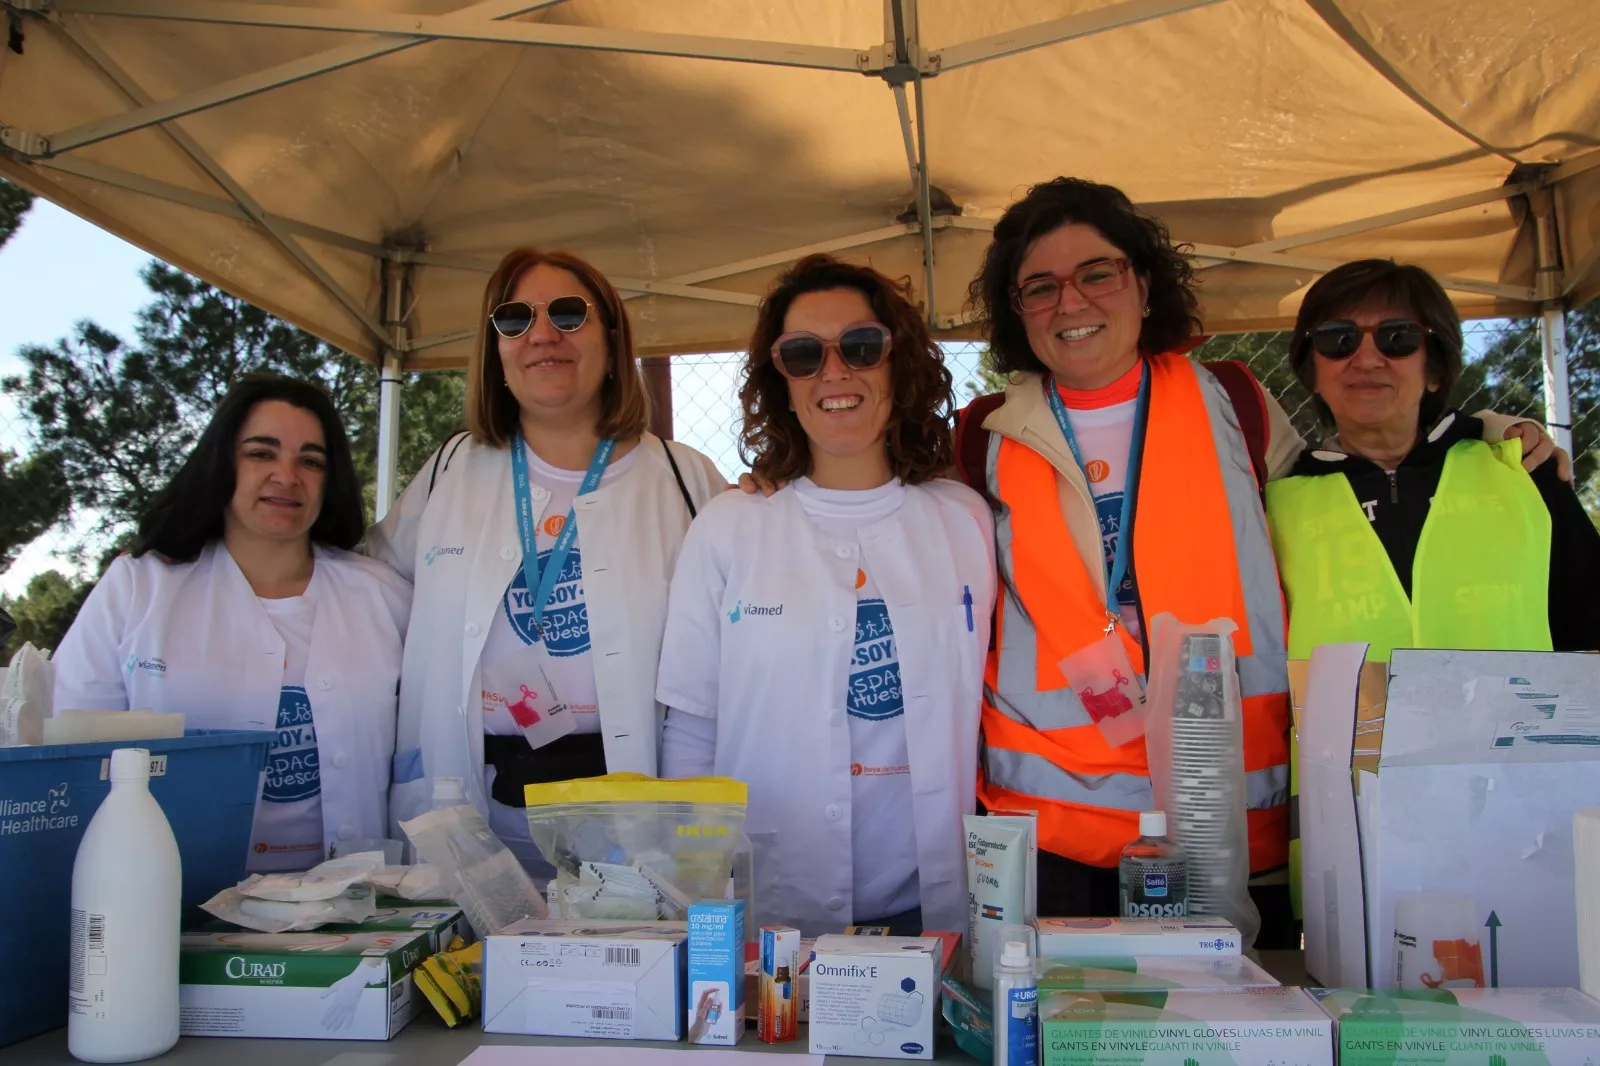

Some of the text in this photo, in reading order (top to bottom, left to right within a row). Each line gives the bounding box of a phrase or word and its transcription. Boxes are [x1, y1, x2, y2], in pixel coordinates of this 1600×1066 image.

[743, 603, 783, 616] viamed
[856, 640, 892, 666] SOY
[1, 814, 78, 835] Healthcare
[816, 963, 878, 978] Omnifix E
[1020, 991, 1038, 1000] URG
[1051, 1029, 1158, 1039] GUANTES DE VINILO
[1158, 1028, 1237, 1038] VINYL GLOVES
[1237, 1027, 1324, 1038] LUVAS EM VINIL
[1401, 1028, 1418, 1037] DE
[1420, 1028, 1457, 1038] VINILO
[1459, 1028, 1543, 1038] VINYL GLOVES
[1545, 1028, 1584, 1038] LUVAS
[1051, 1041, 1148, 1051] GANTS EN VINYLE
[1149, 1041, 1242, 1051] GUANTI IN VINILE
[1346, 1040, 1446, 1051] GANTS EN VINYLE
[1450, 1041, 1546, 1051] GUANTI IN VINILE
